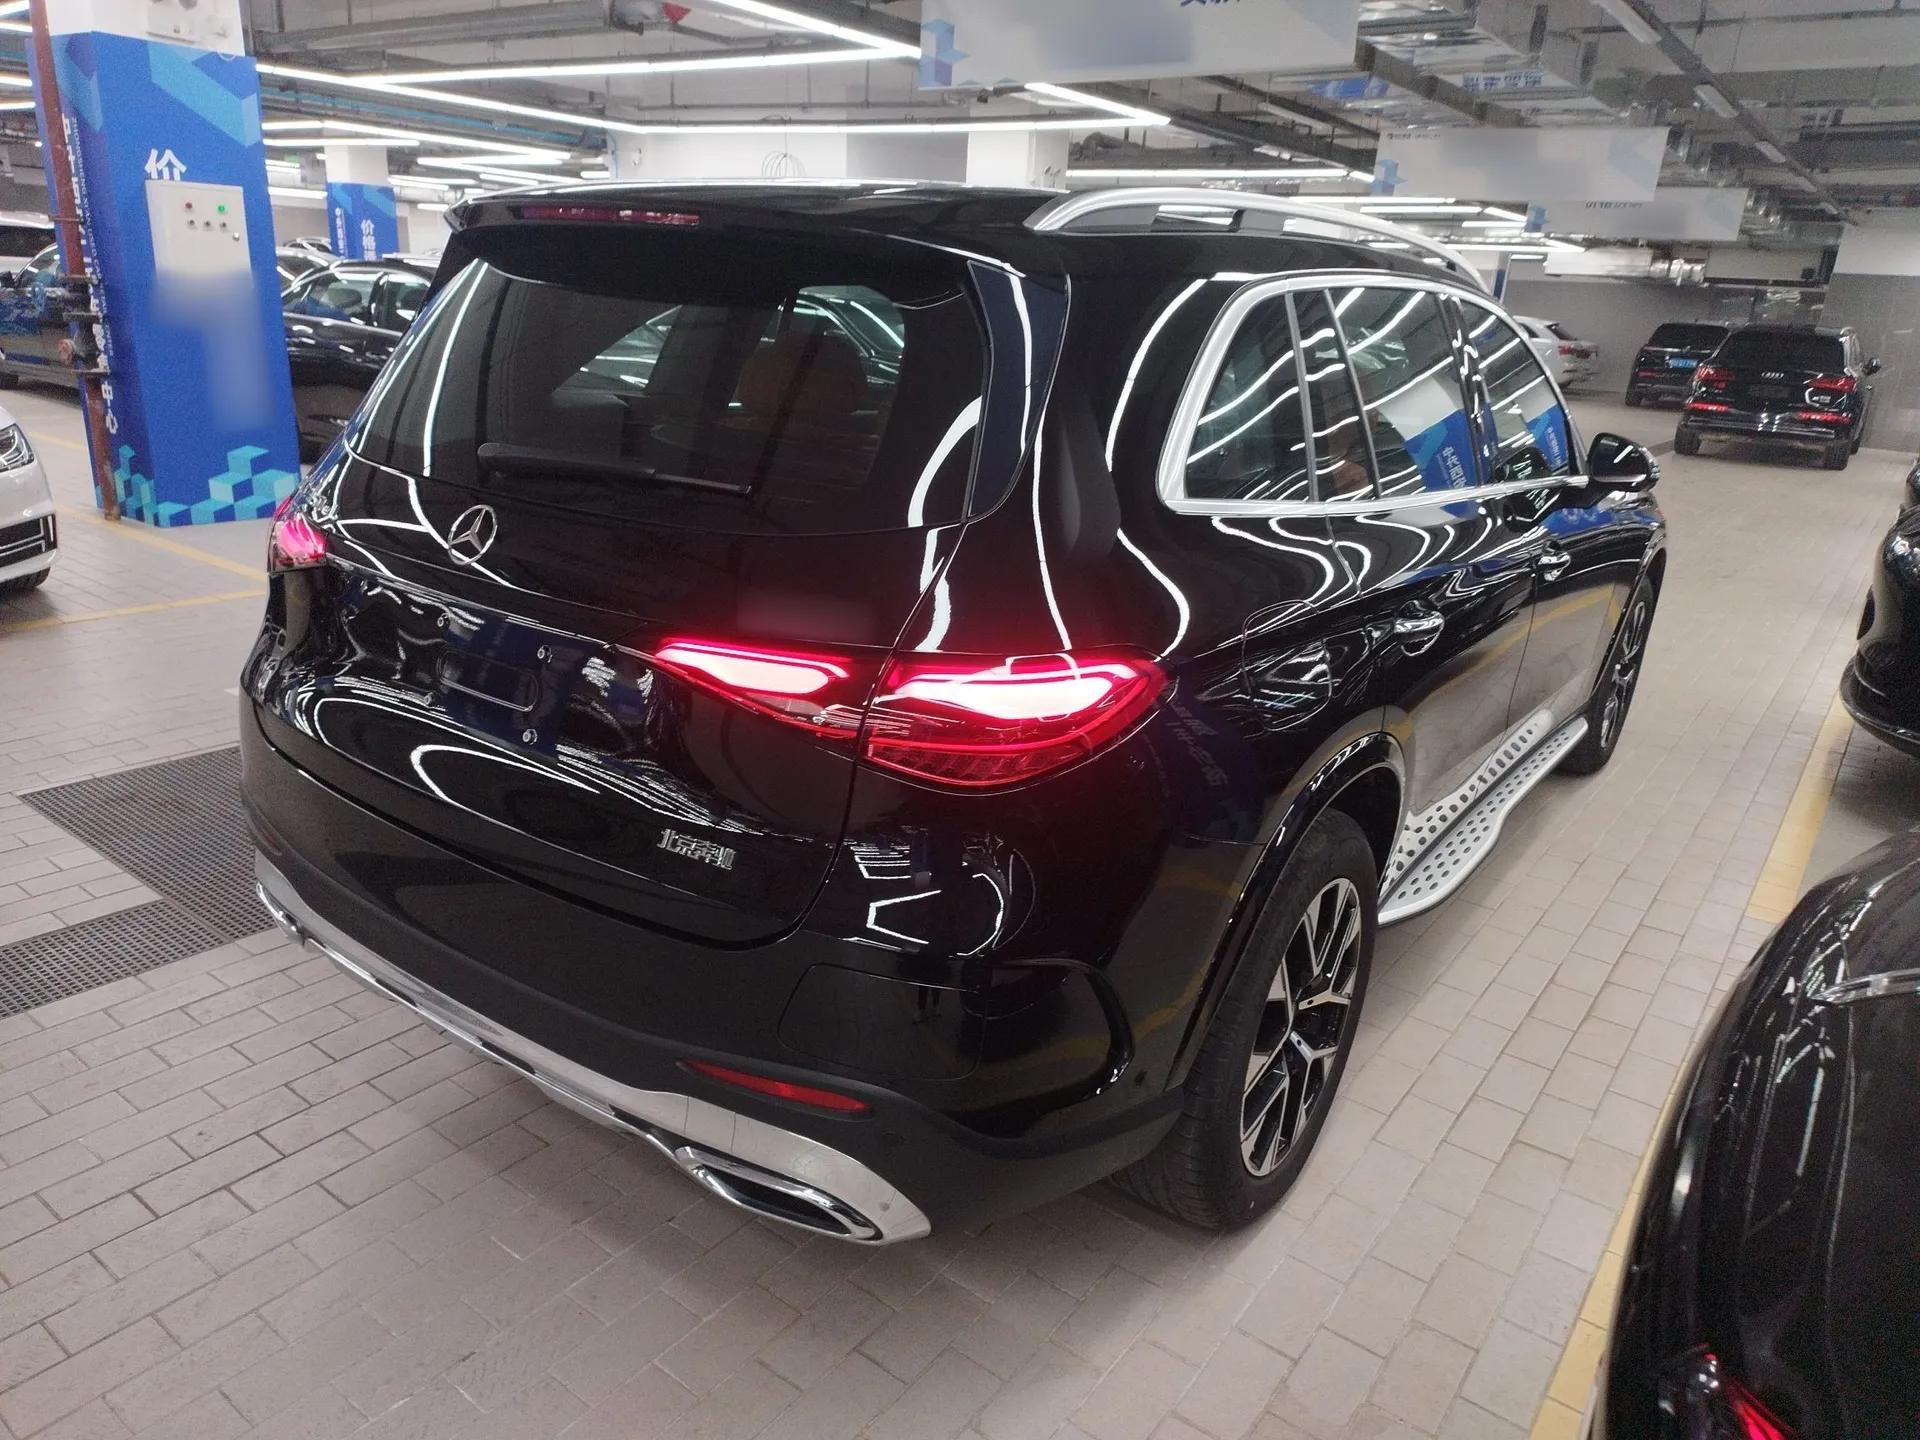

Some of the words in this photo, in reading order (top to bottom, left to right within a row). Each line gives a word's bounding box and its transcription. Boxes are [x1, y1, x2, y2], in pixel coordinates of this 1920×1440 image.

[144, 148, 187, 180] 价
[656, 828, 737, 870] 北京奔驰
